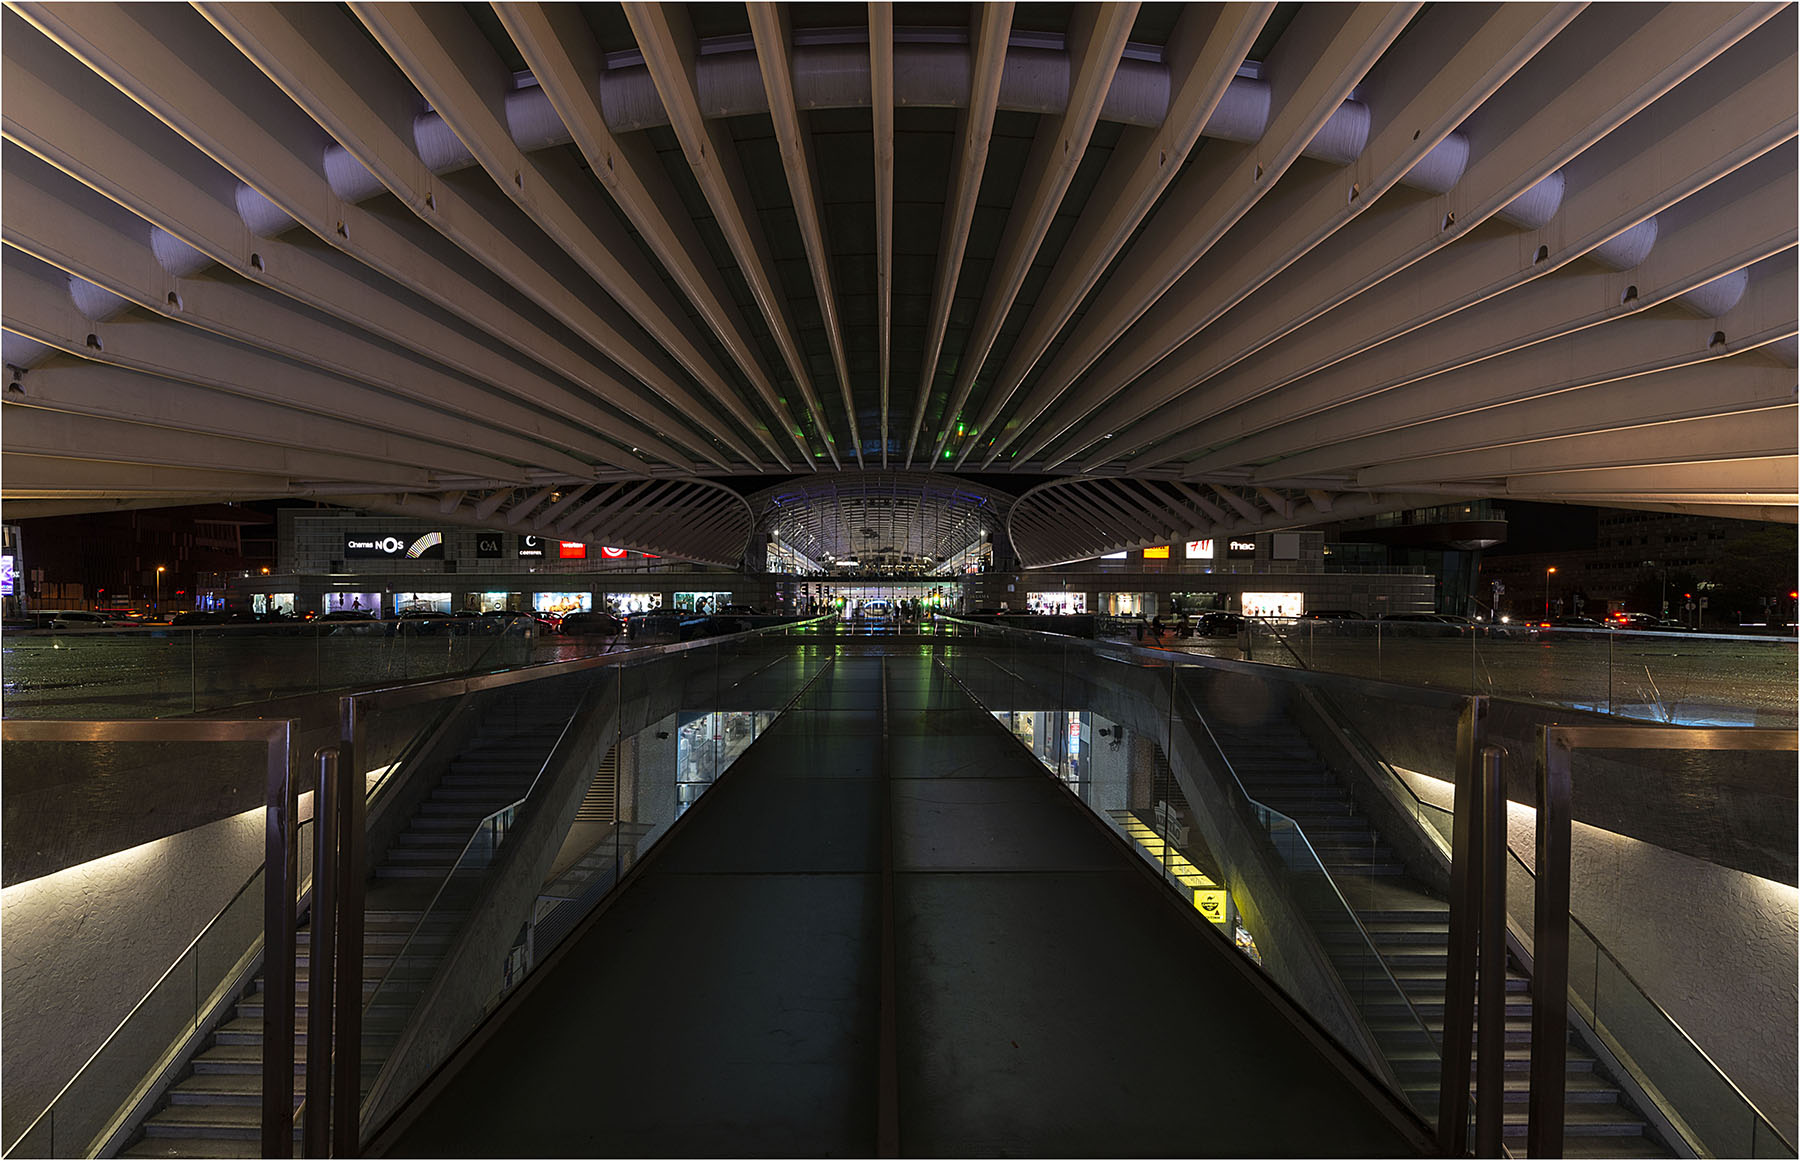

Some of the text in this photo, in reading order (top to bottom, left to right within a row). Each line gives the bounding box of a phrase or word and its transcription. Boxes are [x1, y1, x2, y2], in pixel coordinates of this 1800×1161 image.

[348, 537, 404, 553] Cinemas NOS
[525, 535, 537, 547] C
[1230, 541, 1255, 550] fnac
